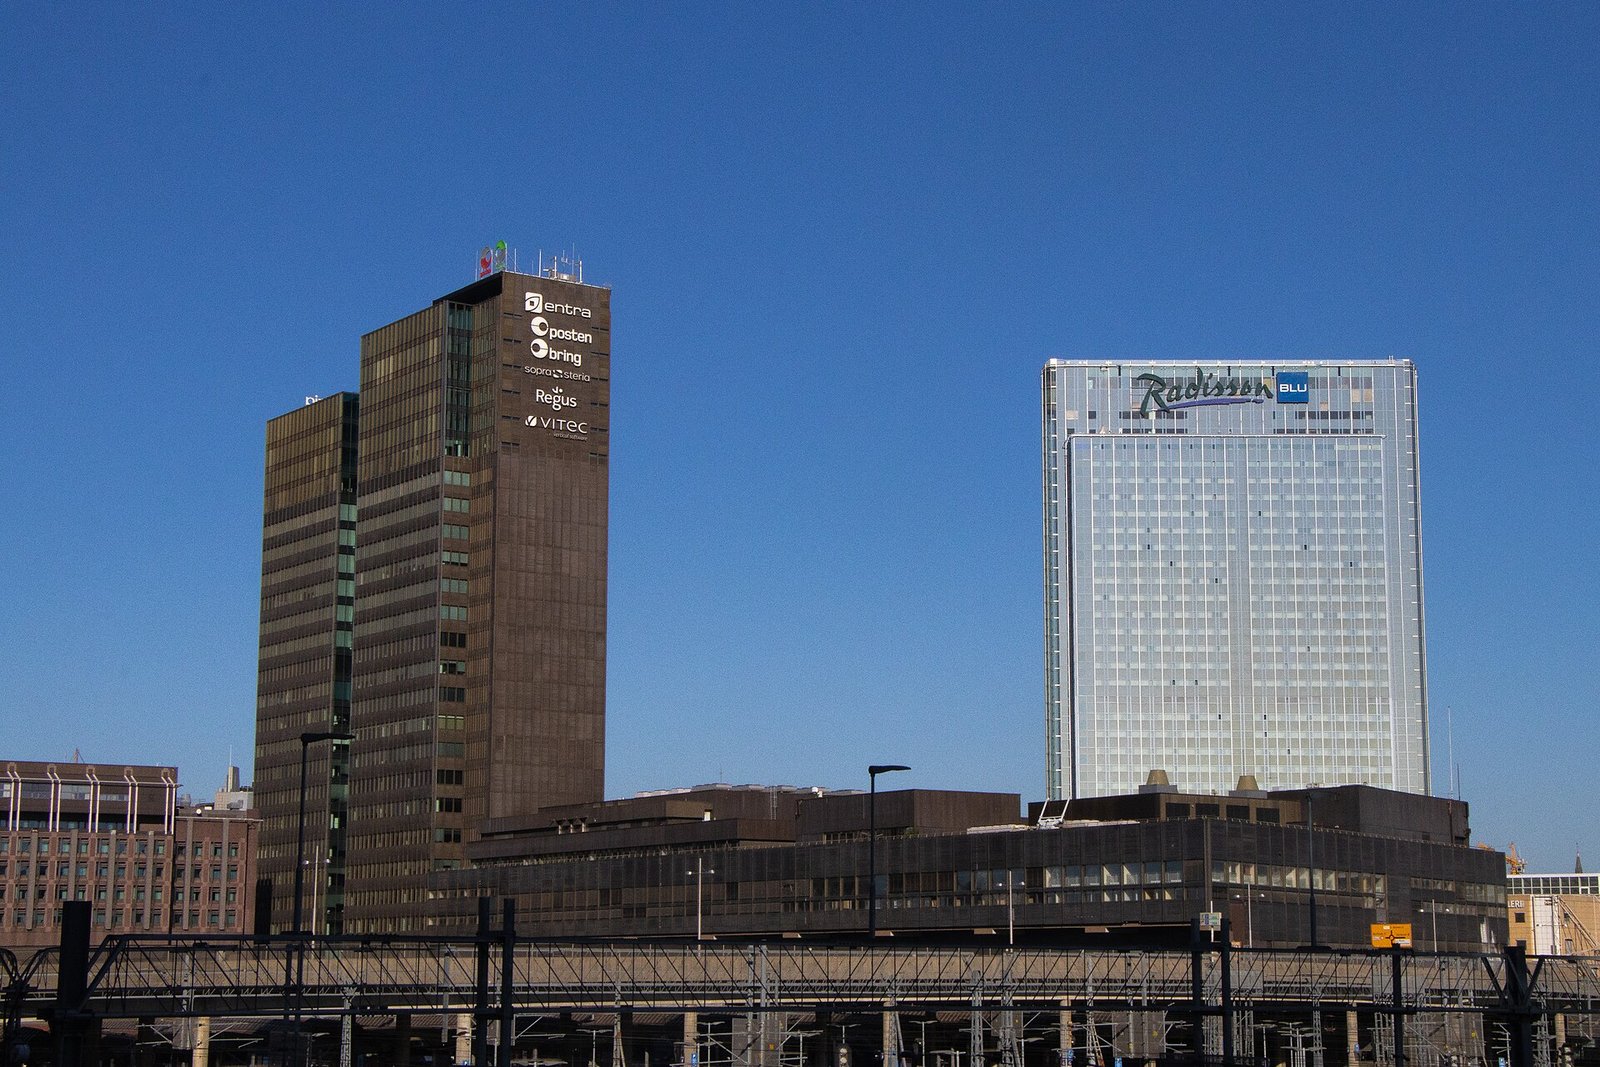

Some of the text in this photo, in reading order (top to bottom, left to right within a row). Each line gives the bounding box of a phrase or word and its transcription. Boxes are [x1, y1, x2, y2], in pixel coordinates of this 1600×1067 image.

[544, 302, 591, 318] entra
[549, 327, 592, 344] posten
[549, 347, 582, 367] bring
[524, 365, 590, 382] sopra steria
[536, 387, 577, 411] Regus
[1136, 366, 1307, 419] Radisson BLU
